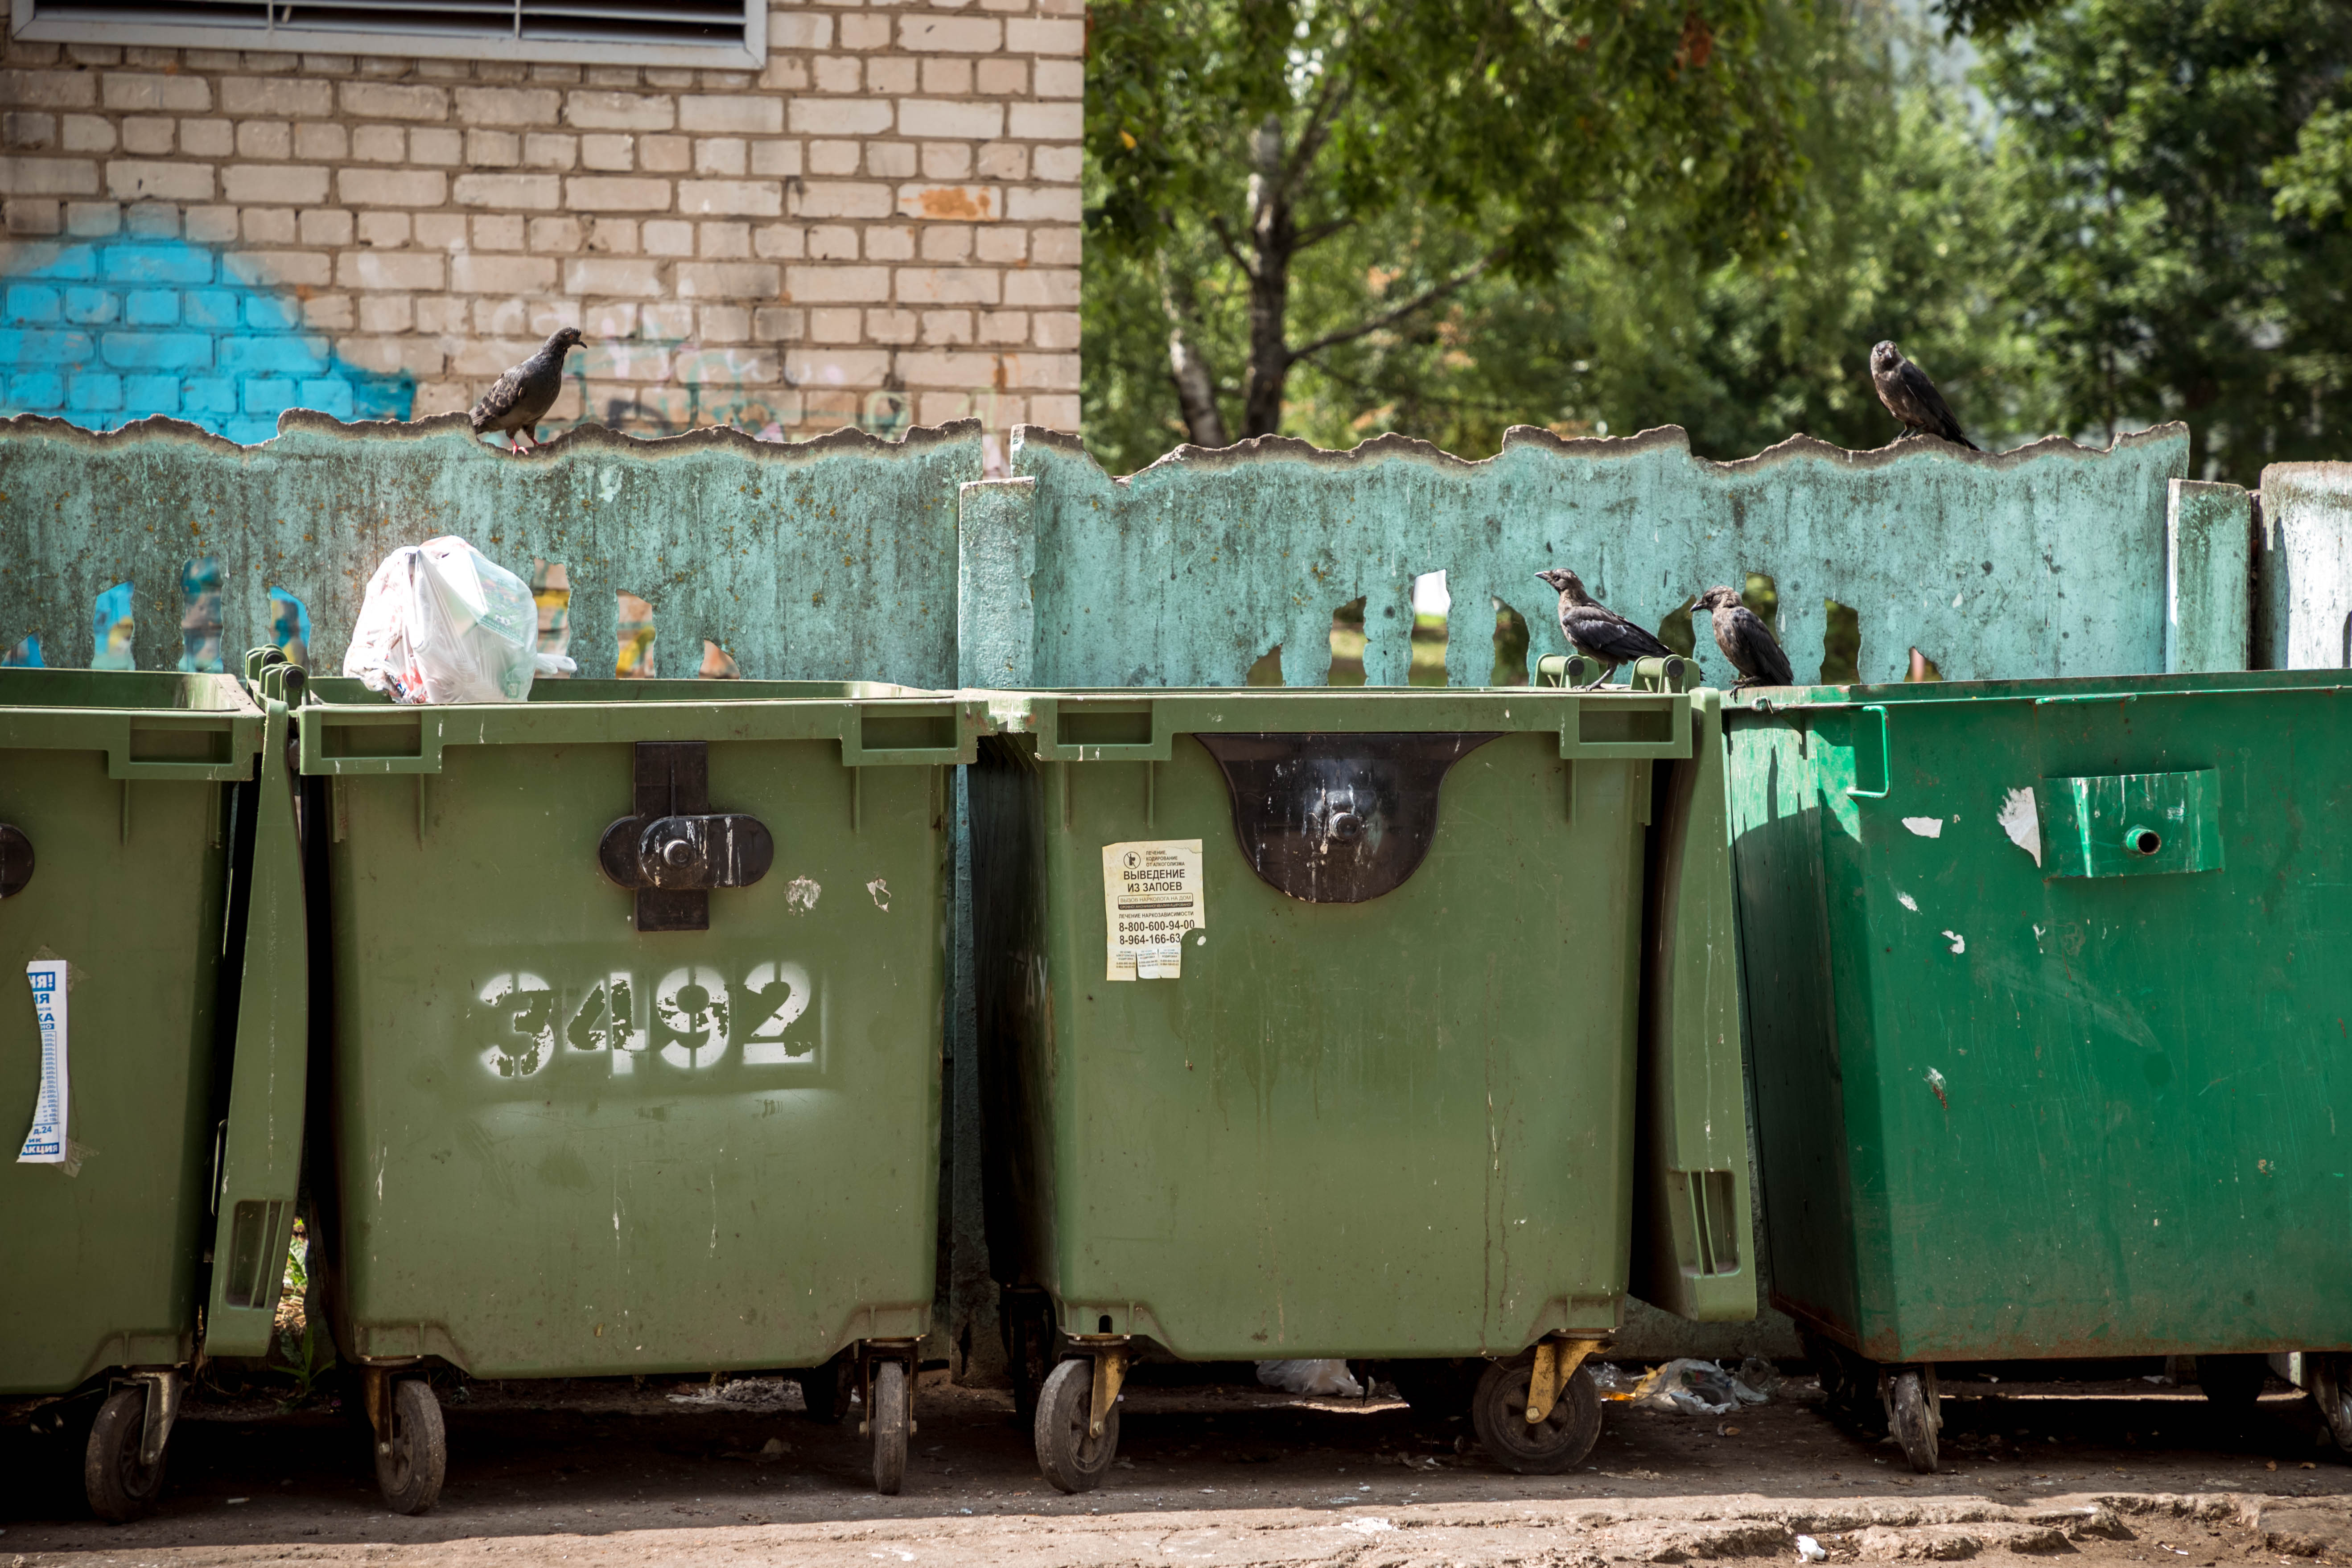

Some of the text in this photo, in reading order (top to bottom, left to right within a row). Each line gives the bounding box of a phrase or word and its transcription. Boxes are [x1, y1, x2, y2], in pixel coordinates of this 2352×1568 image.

[1124, 869, 1186, 881] ВЫВЕДЕНИЕ
[1128, 881, 1182, 893] ИЗ ЗАПОЕВ
[1119, 919, 1195, 932] 8-800-600-94-00
[1120, 933, 1181, 945] 8-964-166-63
[479, 960, 813, 1078] 3492
[23, 1144, 58, 1154] АКЦИЯ
